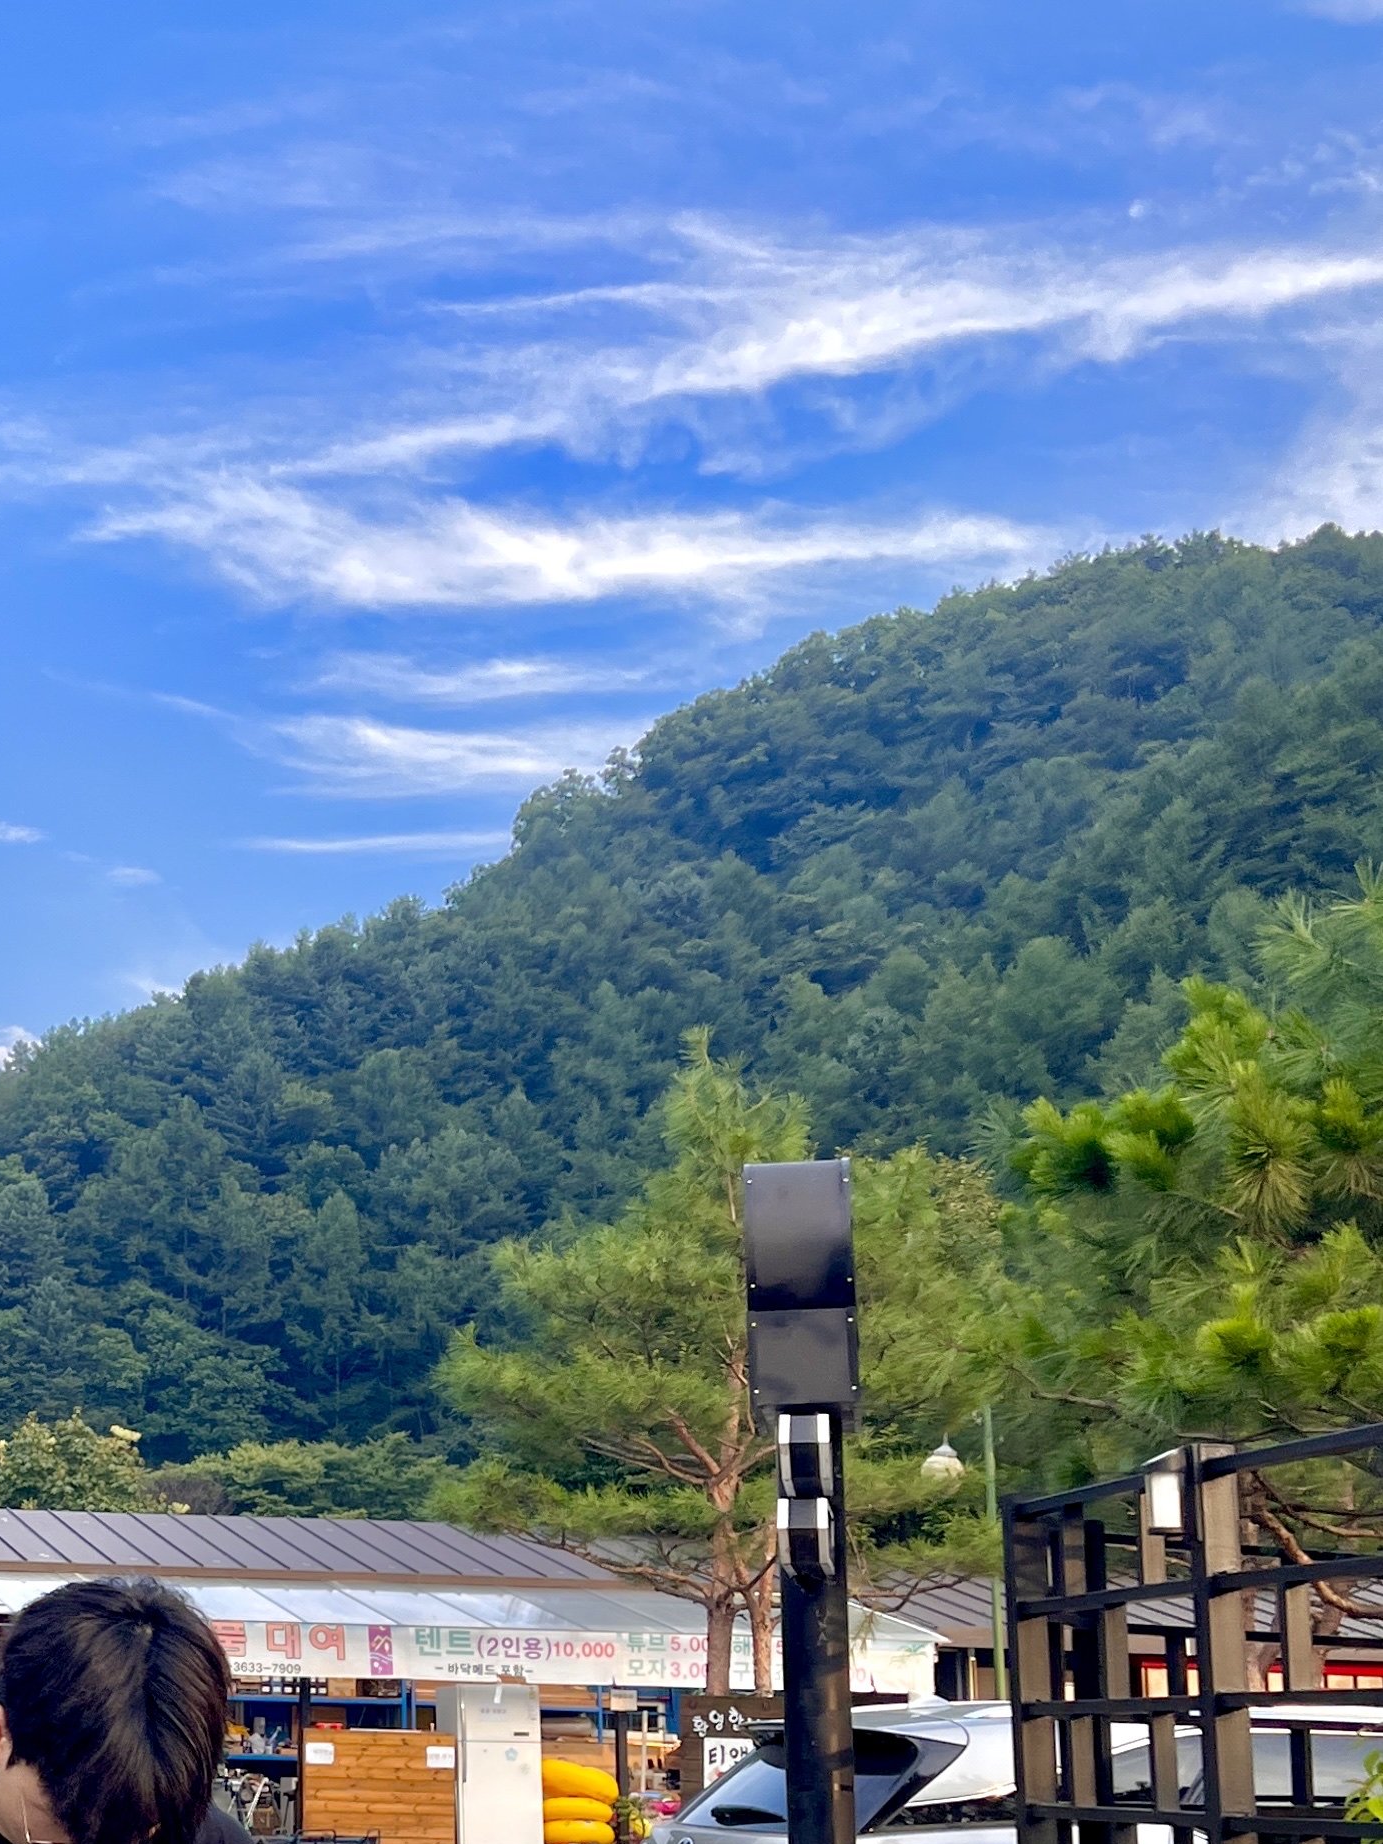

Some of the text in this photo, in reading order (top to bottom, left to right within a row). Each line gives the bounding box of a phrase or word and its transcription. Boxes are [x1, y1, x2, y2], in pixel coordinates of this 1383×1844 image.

[266, 1622, 346, 1661] 대여
[553, 1641, 615, 1658] 10,000
[627, 1658, 667, 1679] 모자
